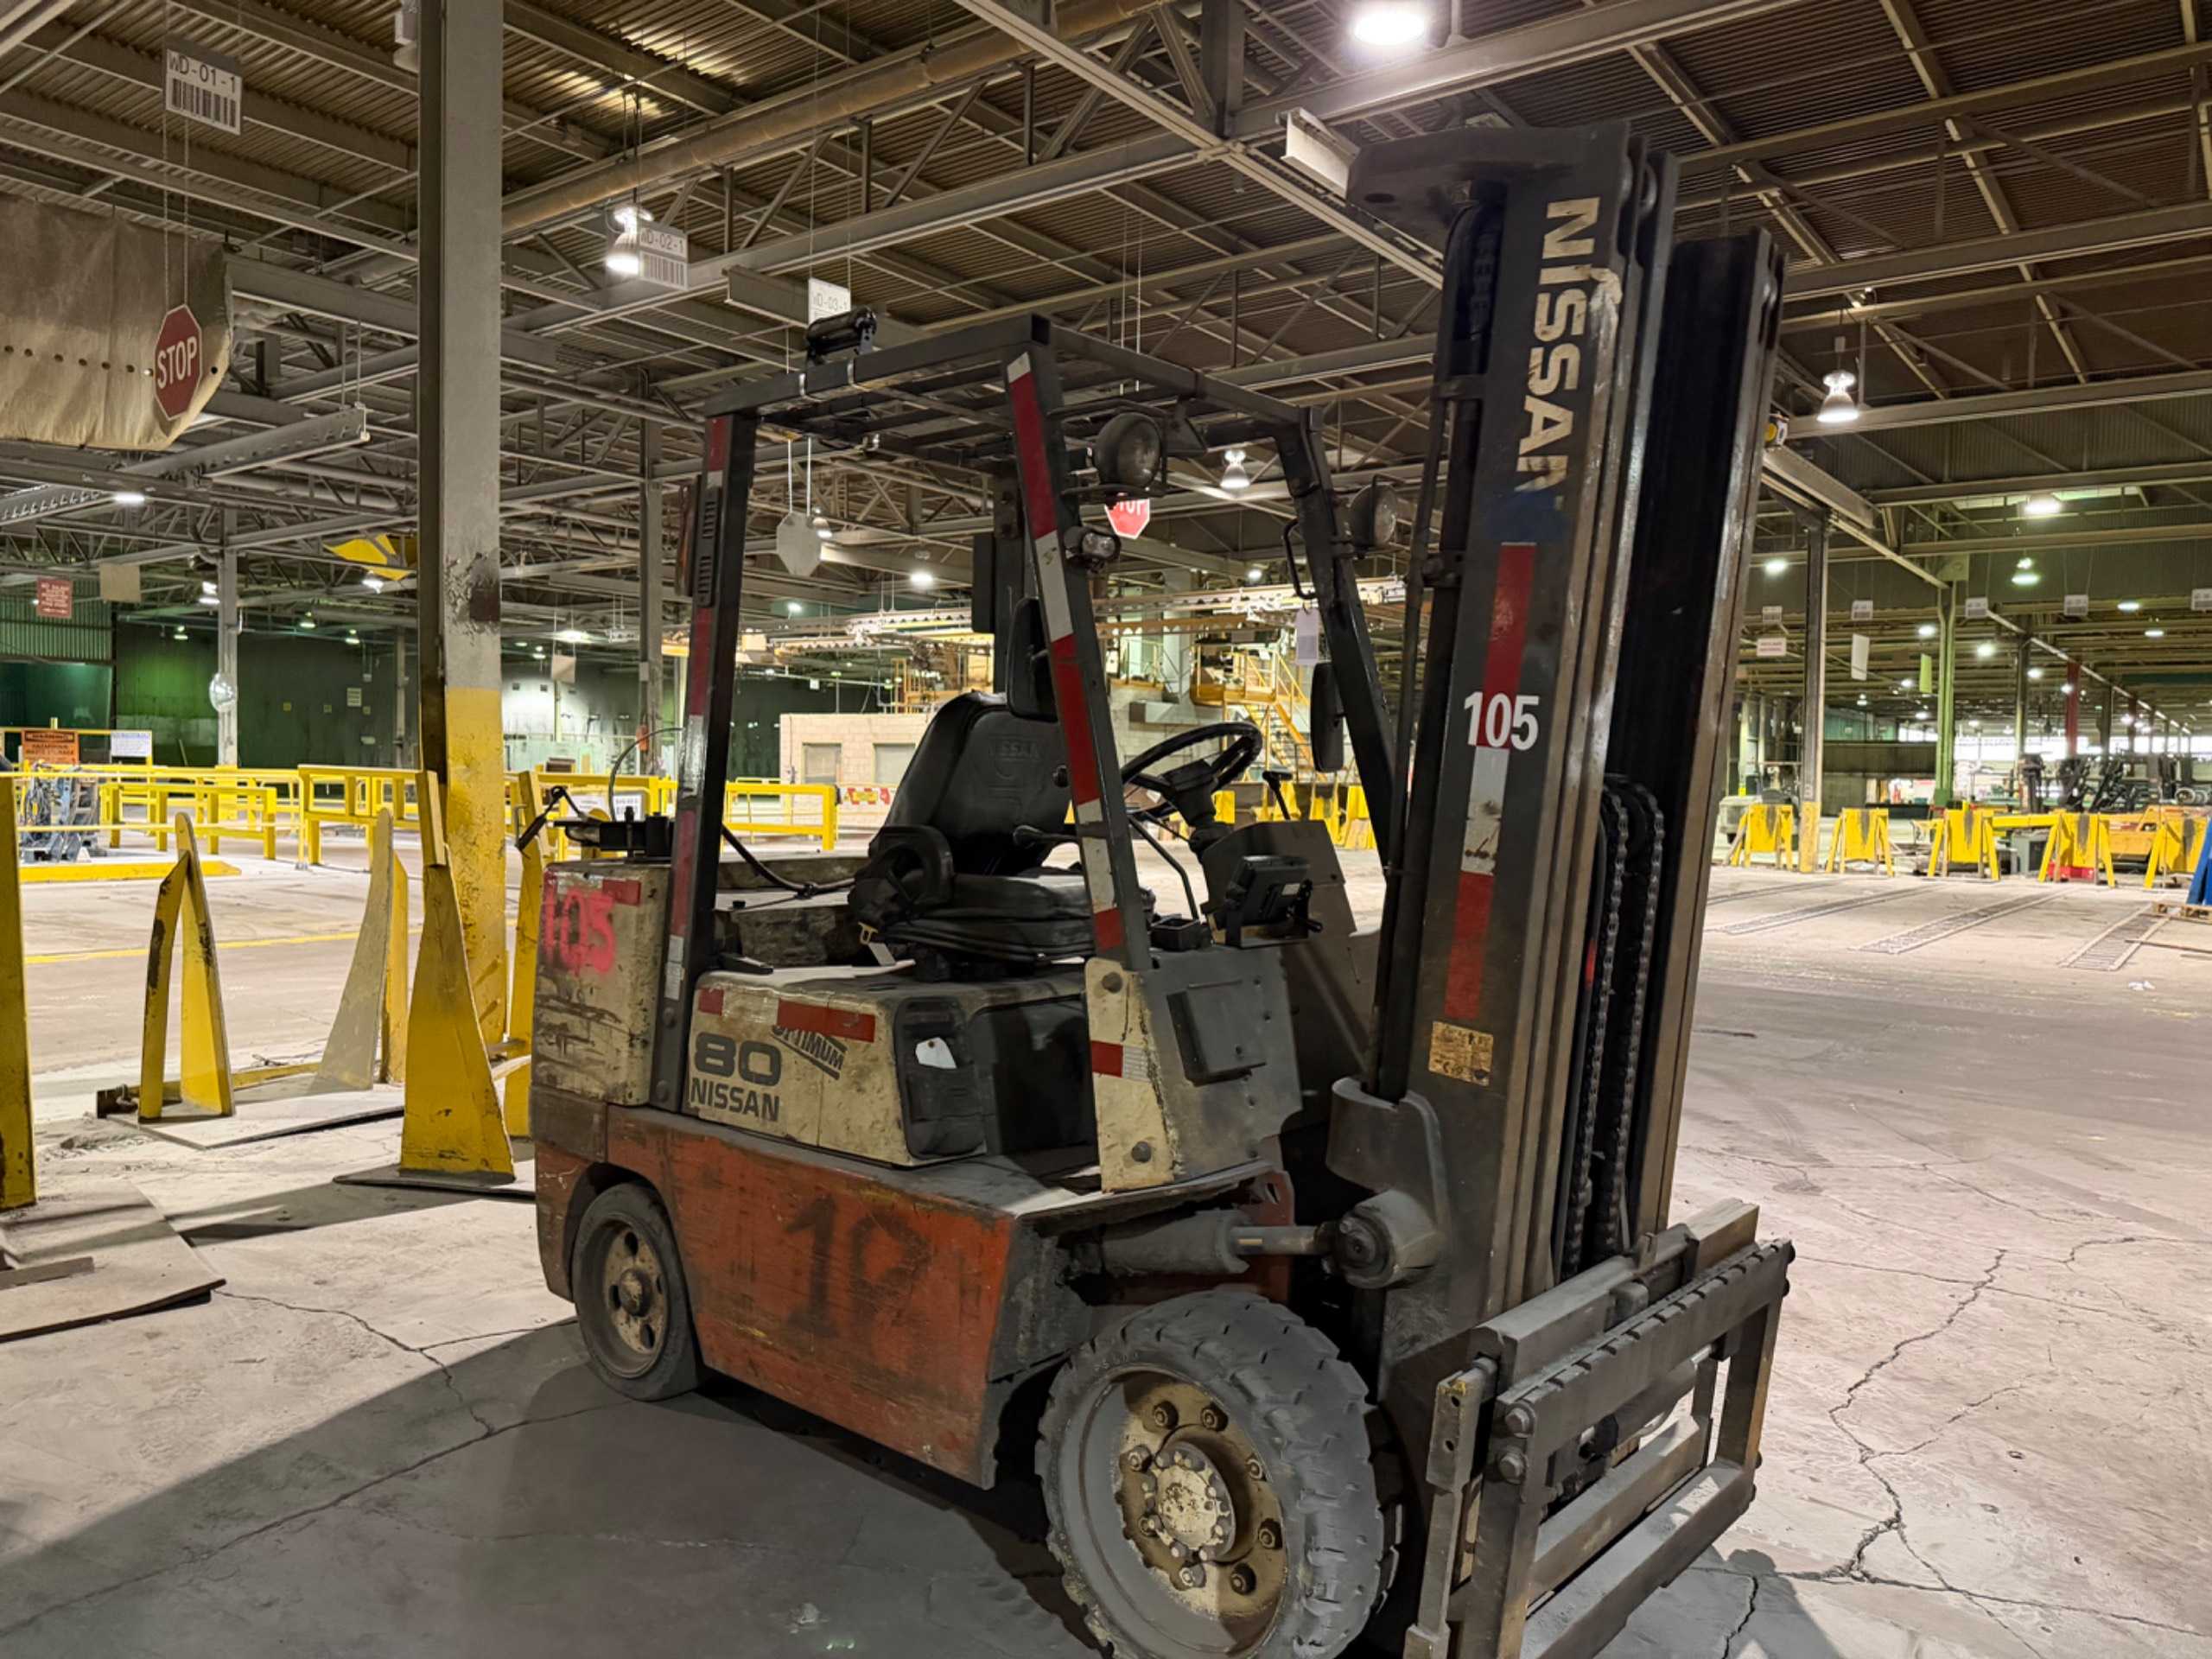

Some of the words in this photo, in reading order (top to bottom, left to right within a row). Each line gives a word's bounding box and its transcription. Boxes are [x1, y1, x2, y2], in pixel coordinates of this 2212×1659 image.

[168, 54, 235, 93] WD-01-1
[157, 336, 198, 389] STOP
[1464, 691, 1540, 751] 105
[543, 883, 617, 973] 105
[694, 1032, 782, 1086] 80
[691, 1077, 780, 1122] NISSAN
